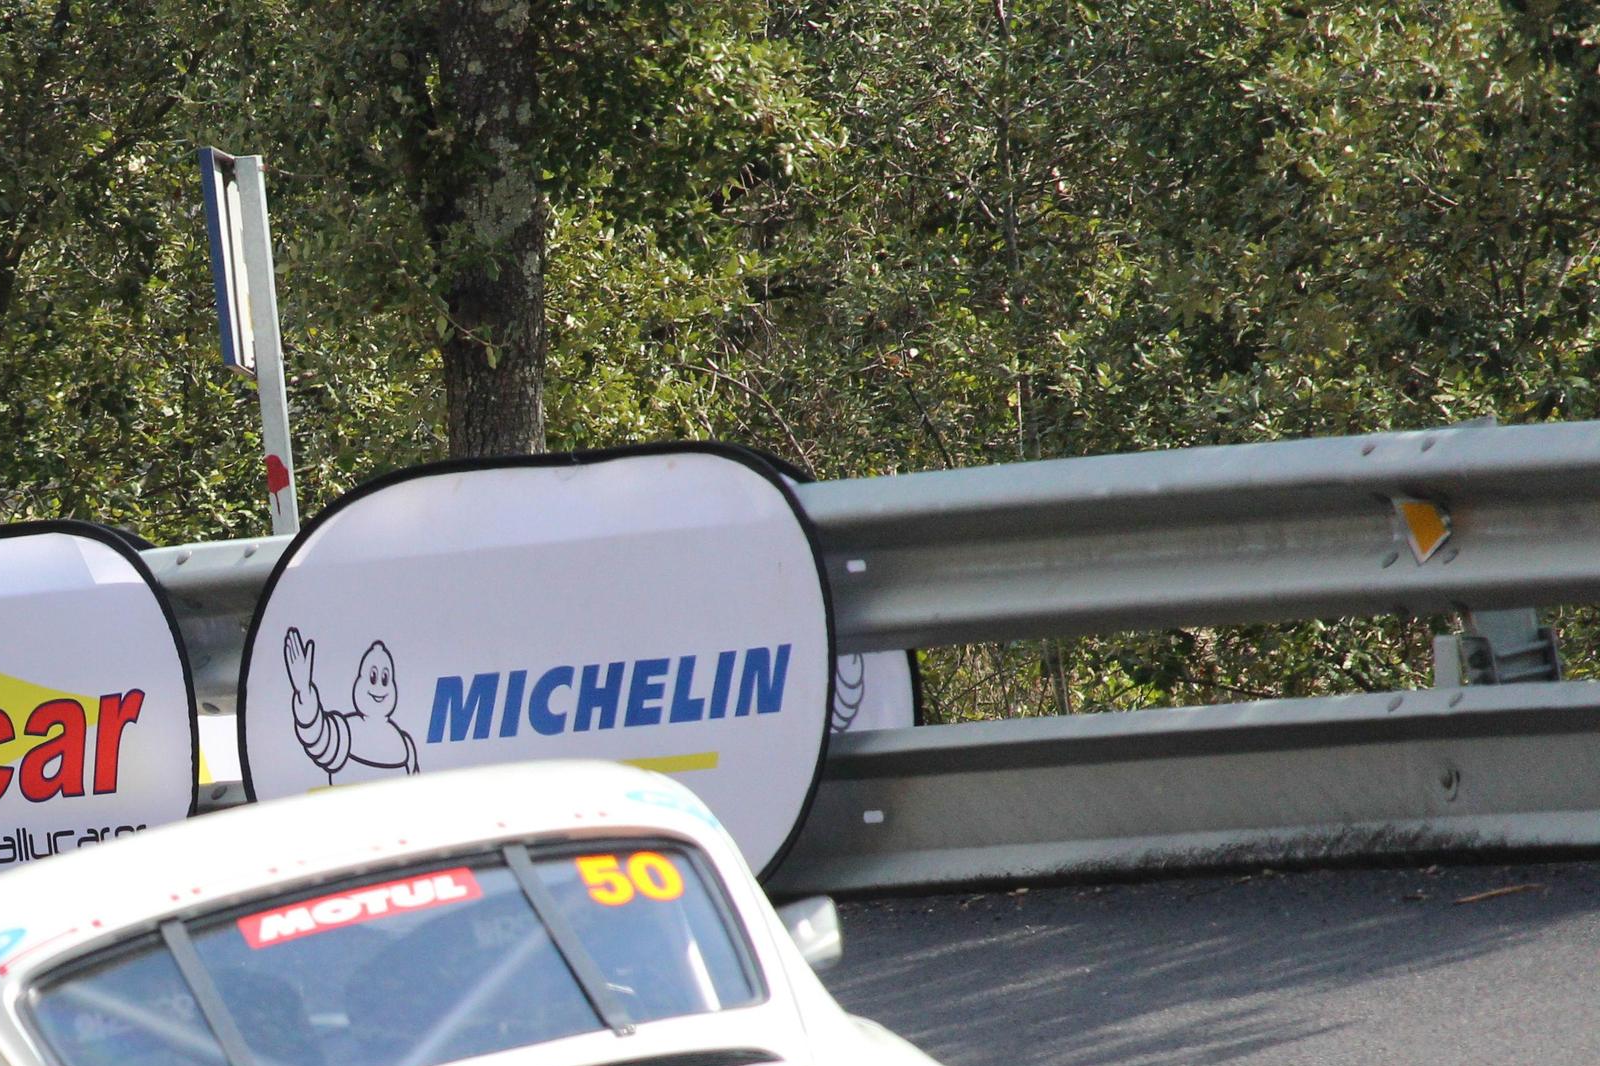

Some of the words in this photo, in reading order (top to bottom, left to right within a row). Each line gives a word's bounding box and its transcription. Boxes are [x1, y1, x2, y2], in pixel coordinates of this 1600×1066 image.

[426, 643, 792, 744] MICHELIN
[258, 874, 468, 943] MOTUL
[573, 849, 685, 907] 50
